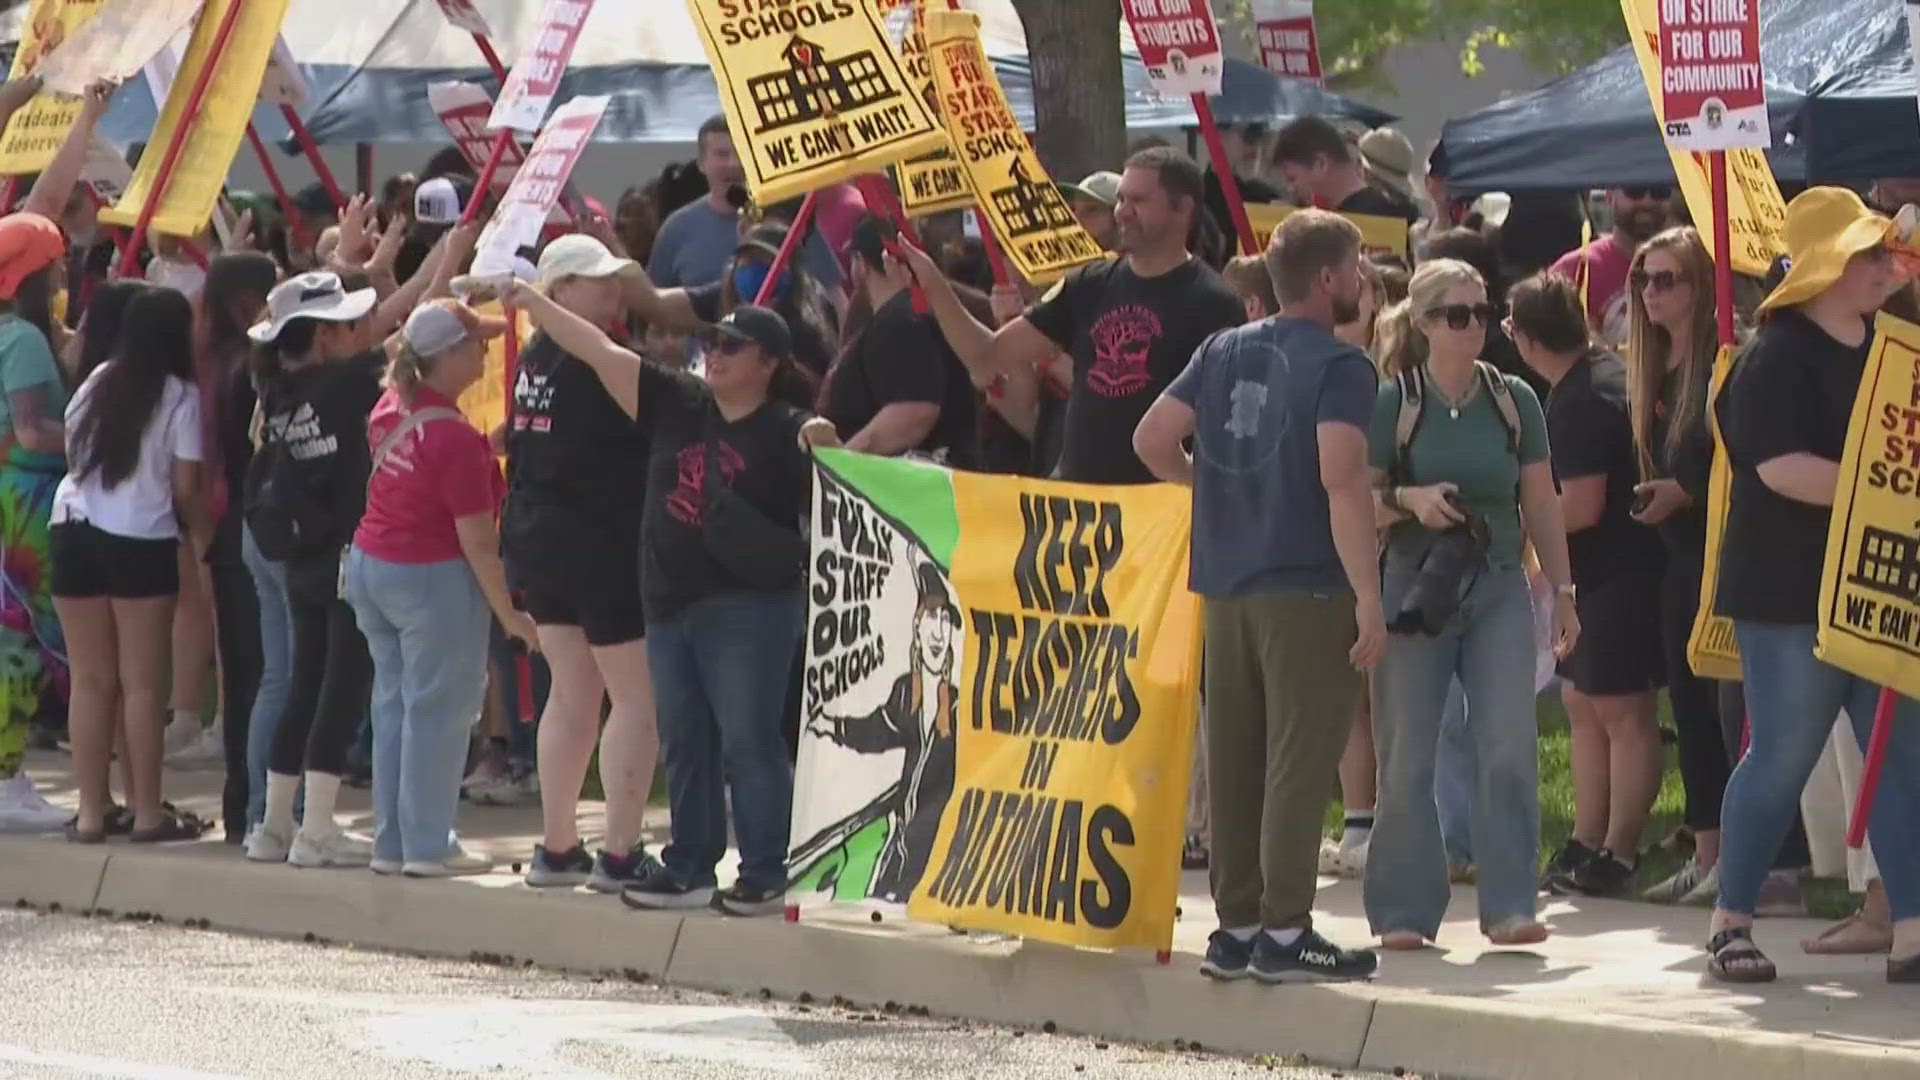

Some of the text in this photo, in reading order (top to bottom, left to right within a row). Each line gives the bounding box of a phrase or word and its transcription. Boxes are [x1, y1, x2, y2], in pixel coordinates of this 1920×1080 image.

[720, 0, 854, 45] SCHOOLS
[1135, 17, 1210, 47] STUDENTS
[1662, 0, 1748, 26] ON STRIKE
[1672, 30, 1704, 61] FOR
[1708, 27, 1744, 59] OUR
[1664, 62, 1760, 93] COMMUNITY
[765, 104, 915, 169] WE CAN'T WAIT!
[910, 171, 932, 198] WE
[816, 470, 893, 565] FULLY
[813, 549, 889, 606] STAFF
[1014, 493, 1123, 617] KEEP
[813, 603, 872, 657] OUR
[1846, 593, 1877, 632] WE
[807, 634, 884, 715] SCHOOLS
[1019, 740, 1059, 791] IN
[928, 788, 1135, 930] NATOMAS
[1298, 948, 1337, 967] HOKA
